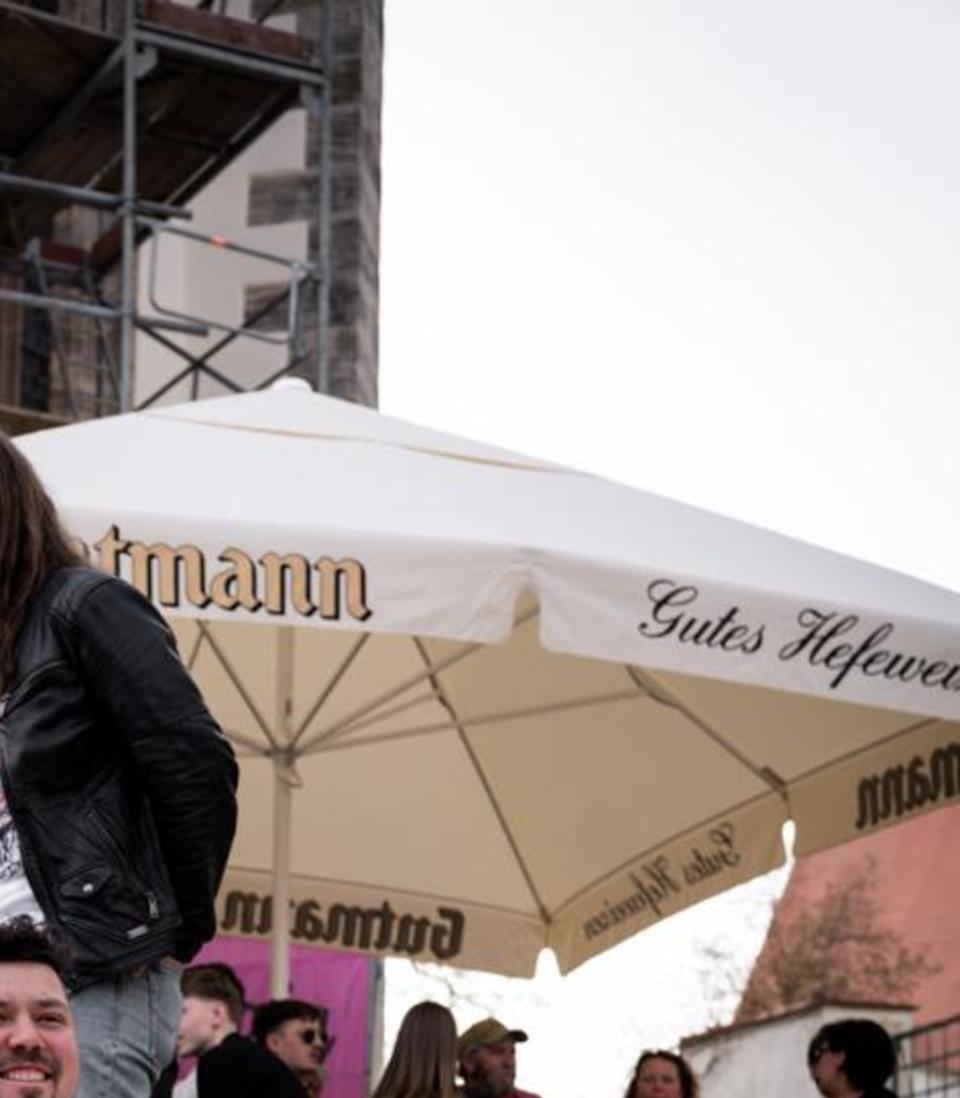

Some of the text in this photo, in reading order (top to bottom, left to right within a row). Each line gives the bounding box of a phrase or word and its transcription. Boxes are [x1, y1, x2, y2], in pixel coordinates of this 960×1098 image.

[76, 524, 372, 620] tmann
[639, 578, 960, 690] Gutes Hefewei
